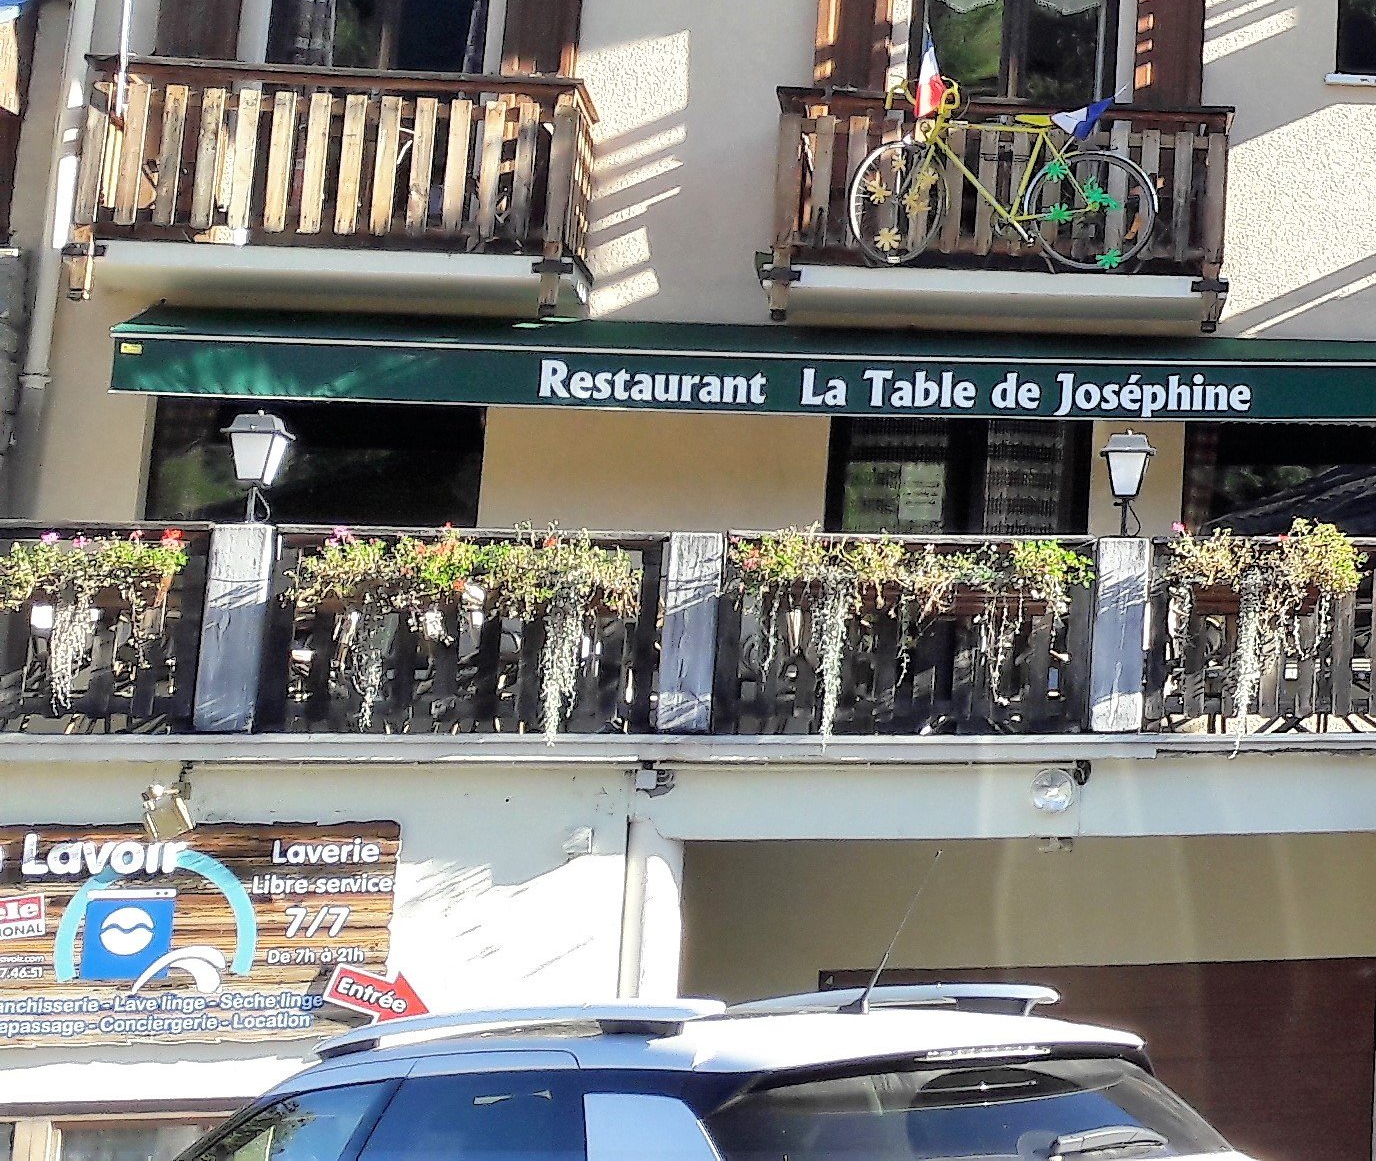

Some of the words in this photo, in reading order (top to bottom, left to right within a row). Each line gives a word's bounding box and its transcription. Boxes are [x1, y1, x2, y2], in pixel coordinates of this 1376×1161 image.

[537, 357, 767, 406] Restaurant
[799, 367, 847, 409] La
[862, 368, 976, 412] Table
[990, 370, 1041, 413] de
[1052, 372, 1252, 419] Joséphine
[21, 832, 188, 875] Lavoir
[272, 836, 381, 865] Laverie
[251, 873, 309, 895] Libre
[315, 873, 394, 894] service
[0, 923, 43, 938] ONAL
[284, 905, 351, 939] 7/7
[267, 950, 291, 964] De
[294, 949, 315, 963] 7h
[321, 948, 334, 963] à
[337, 948, 365, 963] 21h
[114, 997, 158, 1011] Lave
[161, 995, 206, 1013] linge
[220, 993, 275, 1008] Sèche
[279, 992, 323, 1010] linge
[336, 975, 408, 1014] Entrée
[100, 1014, 219, 1035] Conciergerie
[232, 1013, 311, 1029] Location
